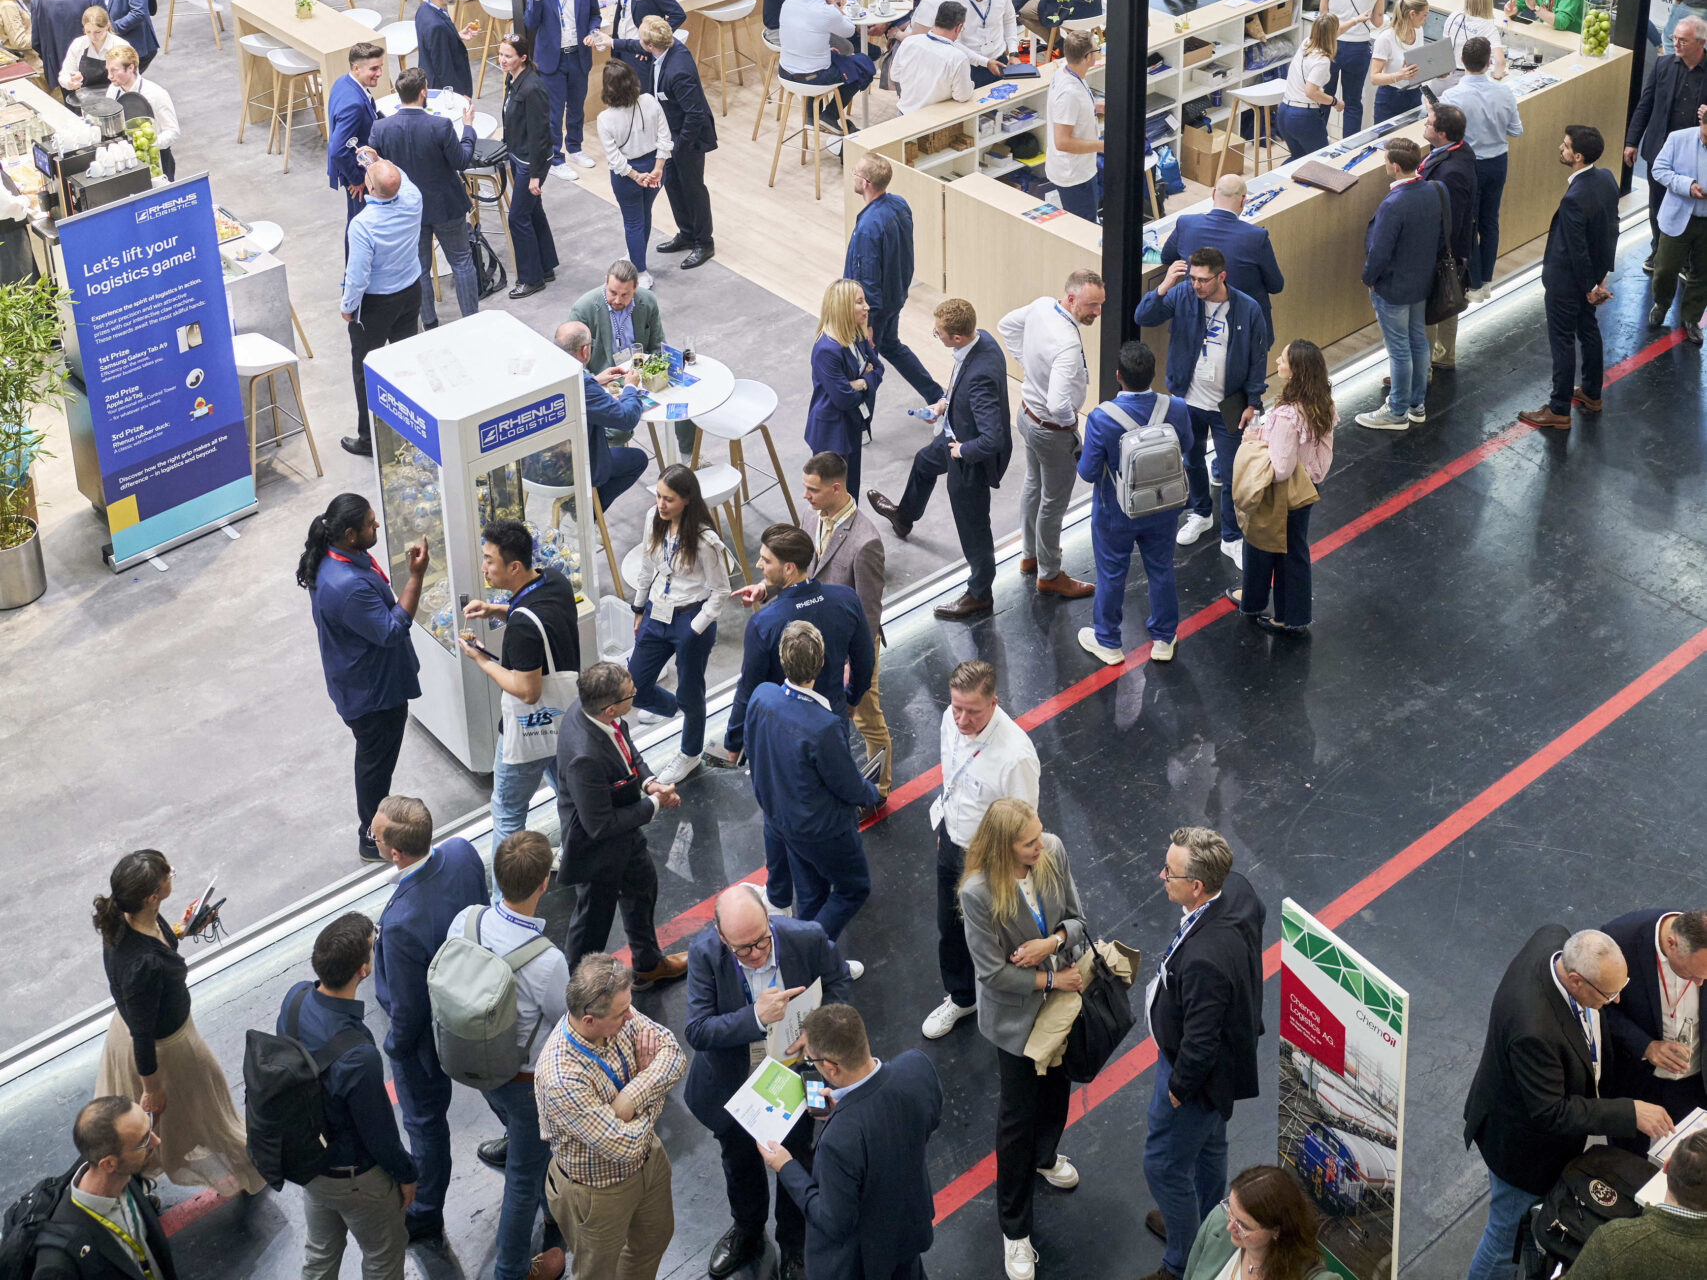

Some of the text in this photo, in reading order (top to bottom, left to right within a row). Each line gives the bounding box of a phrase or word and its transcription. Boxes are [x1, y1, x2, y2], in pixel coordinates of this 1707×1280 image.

[149, 192, 197, 215] RHENUS
[150, 200, 198, 220] LOGISTICS
[122, 246, 143, 264] lift
[145, 235, 179, 259] your
[86, 246, 196, 297] logistics game!
[91, 307, 123, 322] Experience
[133, 297, 148, 307] spirit
[155, 288, 178, 300] logistics
[105, 319, 117, 328] your
[118, 310, 142, 322] precision
[142, 305, 153, 313] and
[163, 292, 187, 306] attractive
[94, 329, 110, 338] prizes
[111, 324, 123, 332] with
[132, 310, 160, 324] interactive
[160, 306, 172, 314] claw
[95, 336, 112, 344] These
[112, 327, 134, 339] rewards
[134, 321, 149, 331] await
[159, 313, 172, 322] most
[98, 349, 130, 364] 1st Prize
[99, 358, 127, 372] Samsung
[127, 350, 147, 361] Galaxy
[159, 341, 168, 349] A9
[104, 385, 139, 403] 2nd Prize
[106, 399, 124, 410] Apple
[387, 392, 426, 430] RHENUS
[387, 403, 427, 439] LOGISTICS
[499, 398, 565, 432] RHENUS
[499, 409, 565, 441] LOGISTICS
[112, 424, 144, 441] 3rd Prize
[112, 437, 135, 448] Rhenus
[135, 429, 154, 439] rubber
[118, 470, 144, 484] Discover
[144, 465, 157, 473] how
[167, 454, 181, 464] right
[181, 450, 193, 459] grip
[193, 442, 211, 453] makes
[218, 434, 228, 442] the
[120, 476, 149, 491] difference
[161, 461, 184, 474] logistics
[184, 456, 196, 464] and
[796, 595, 824, 610] RHENUS
[527, 712, 552, 727] LiS
[1290, 993, 1320, 1023] ChemOil
[1290, 1003, 1321, 1034] Logistics
[1356, 1009, 1396, 1047] ChemOil
